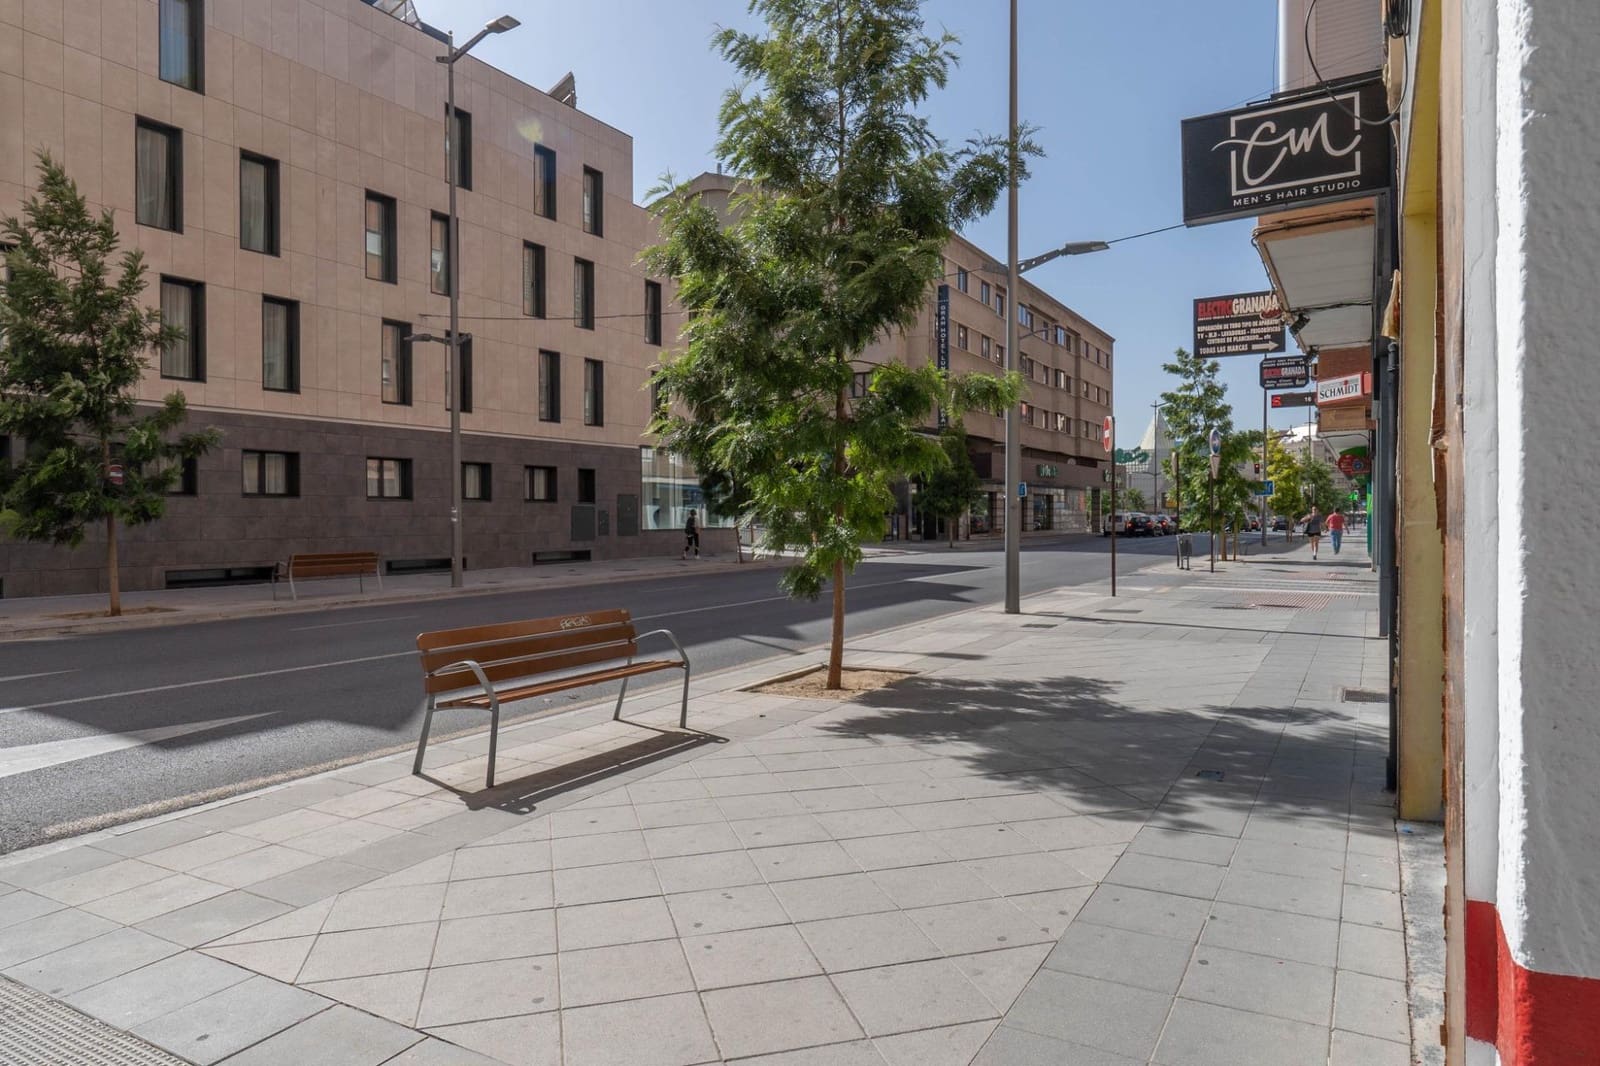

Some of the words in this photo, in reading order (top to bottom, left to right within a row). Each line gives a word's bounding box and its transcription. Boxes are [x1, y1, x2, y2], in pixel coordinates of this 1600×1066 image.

[1232, 193, 1272, 207] MEN'S
[1276, 188, 1307, 200] HAIR
[1312, 179, 1361, 194] STUDIO
[1199, 346, 1216, 355] TODAS
[1217, 345, 1226, 353] LAS
[1227, 343, 1248, 352] MARCAS
[1319, 380, 1360, 399] SCHMIDT
